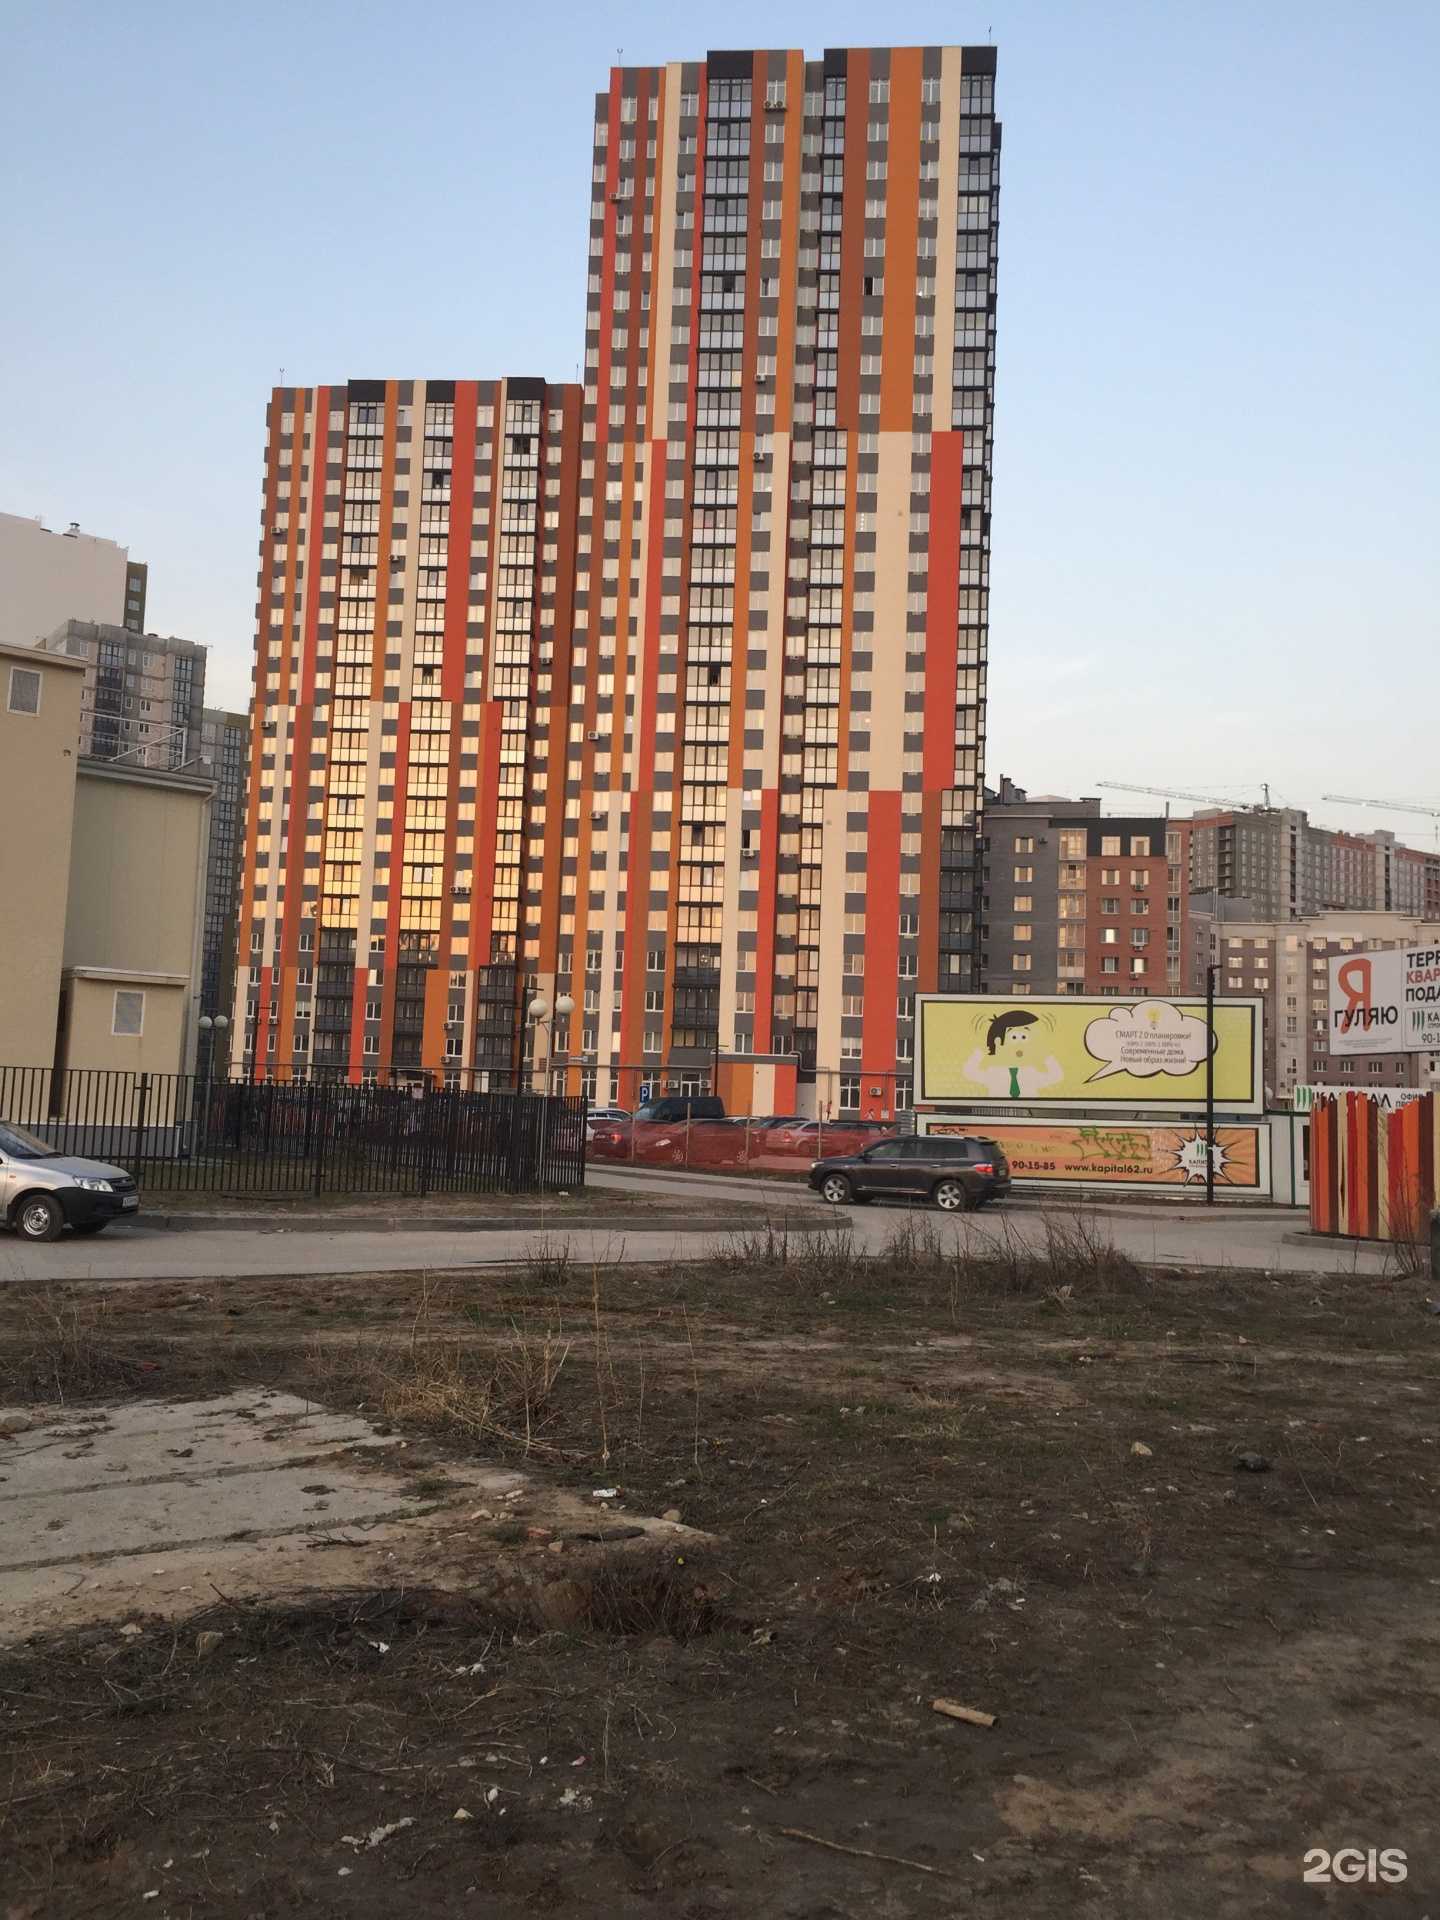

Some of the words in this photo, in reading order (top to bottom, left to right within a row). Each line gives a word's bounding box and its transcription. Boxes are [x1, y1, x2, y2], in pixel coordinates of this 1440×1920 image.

[1338, 958, 1372, 1034] Я
[1334, 1005, 1398, 1028] ГУЛЯЮ
[1115, 1030, 1138, 1039] СМАРТ
[1149, 1032, 1191, 1041] планировки!
[1120, 1047, 1166, 1056] Современные
[1143, 1056, 1162, 1065] образ
[1011, 1160, 1056, 1171] 90-15-85
[1064, 1163, 1153, 1175] www.kapital62.ru
